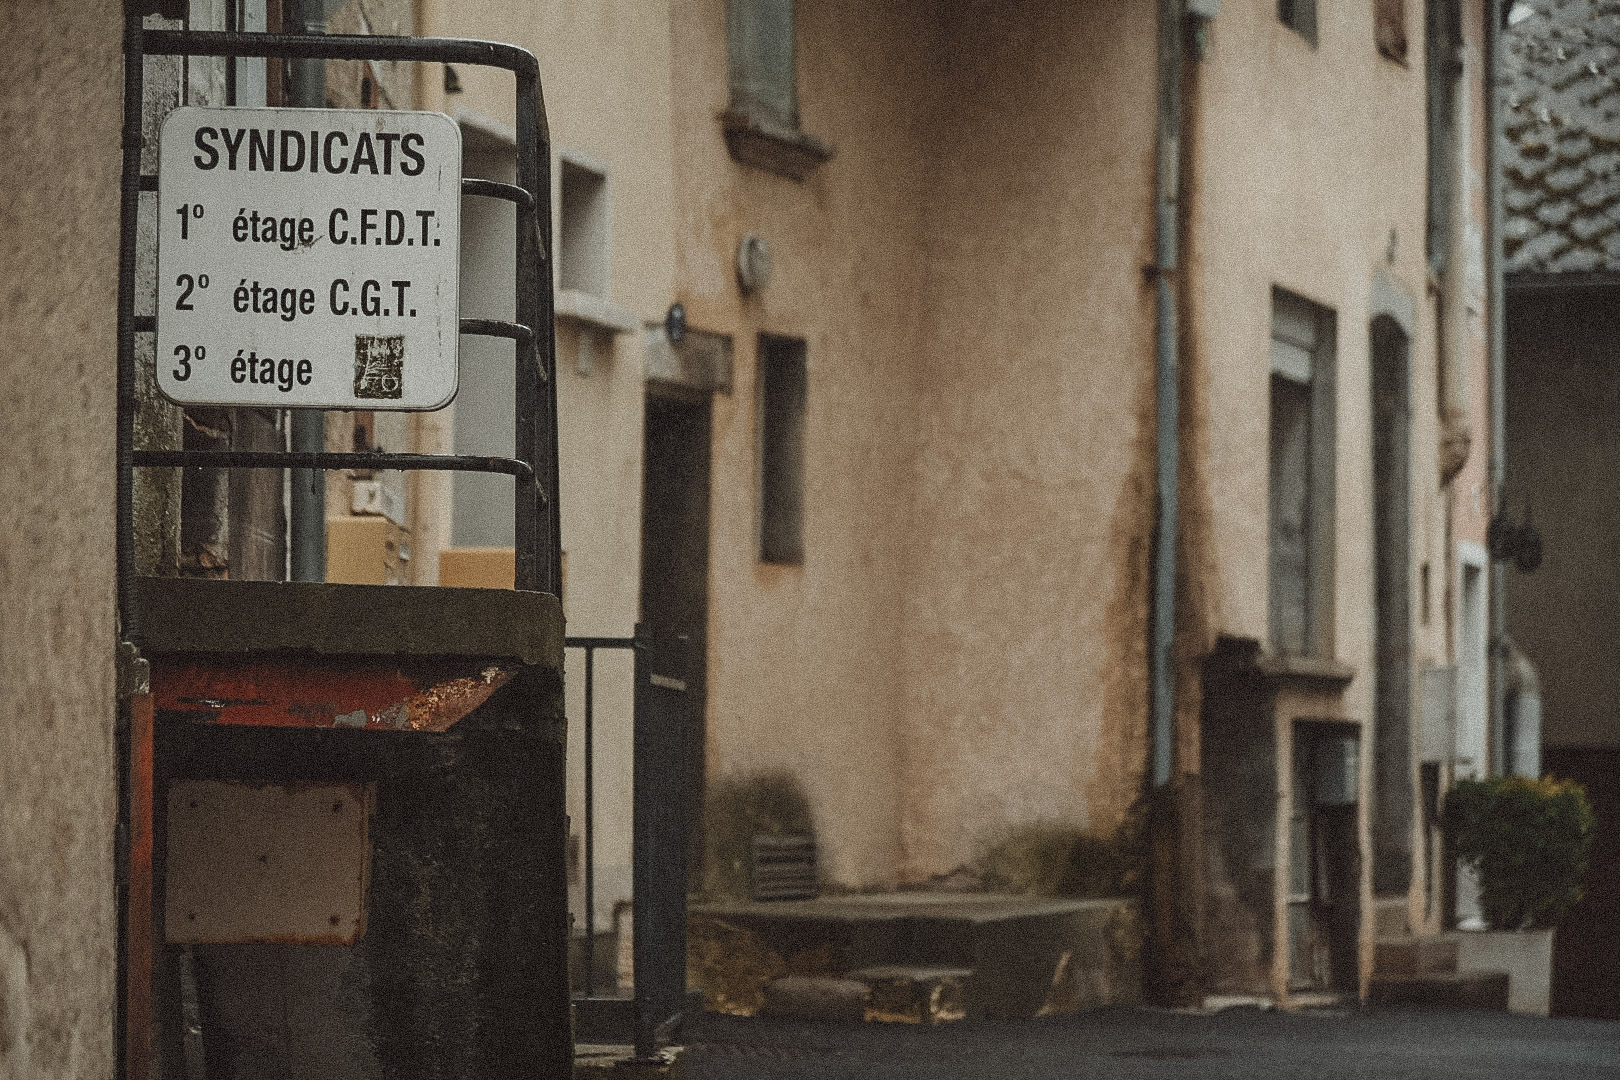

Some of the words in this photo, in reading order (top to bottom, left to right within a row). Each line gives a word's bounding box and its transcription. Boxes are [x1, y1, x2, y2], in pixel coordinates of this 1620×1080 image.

[193, 126, 426, 176] SYNDICATS
[232, 208, 315, 251] étage
[328, 207, 441, 246] C.F.D.T.
[232, 279, 315, 322] étage
[329, 278, 417, 317] C.G.T.
[230, 350, 313, 392] étage
